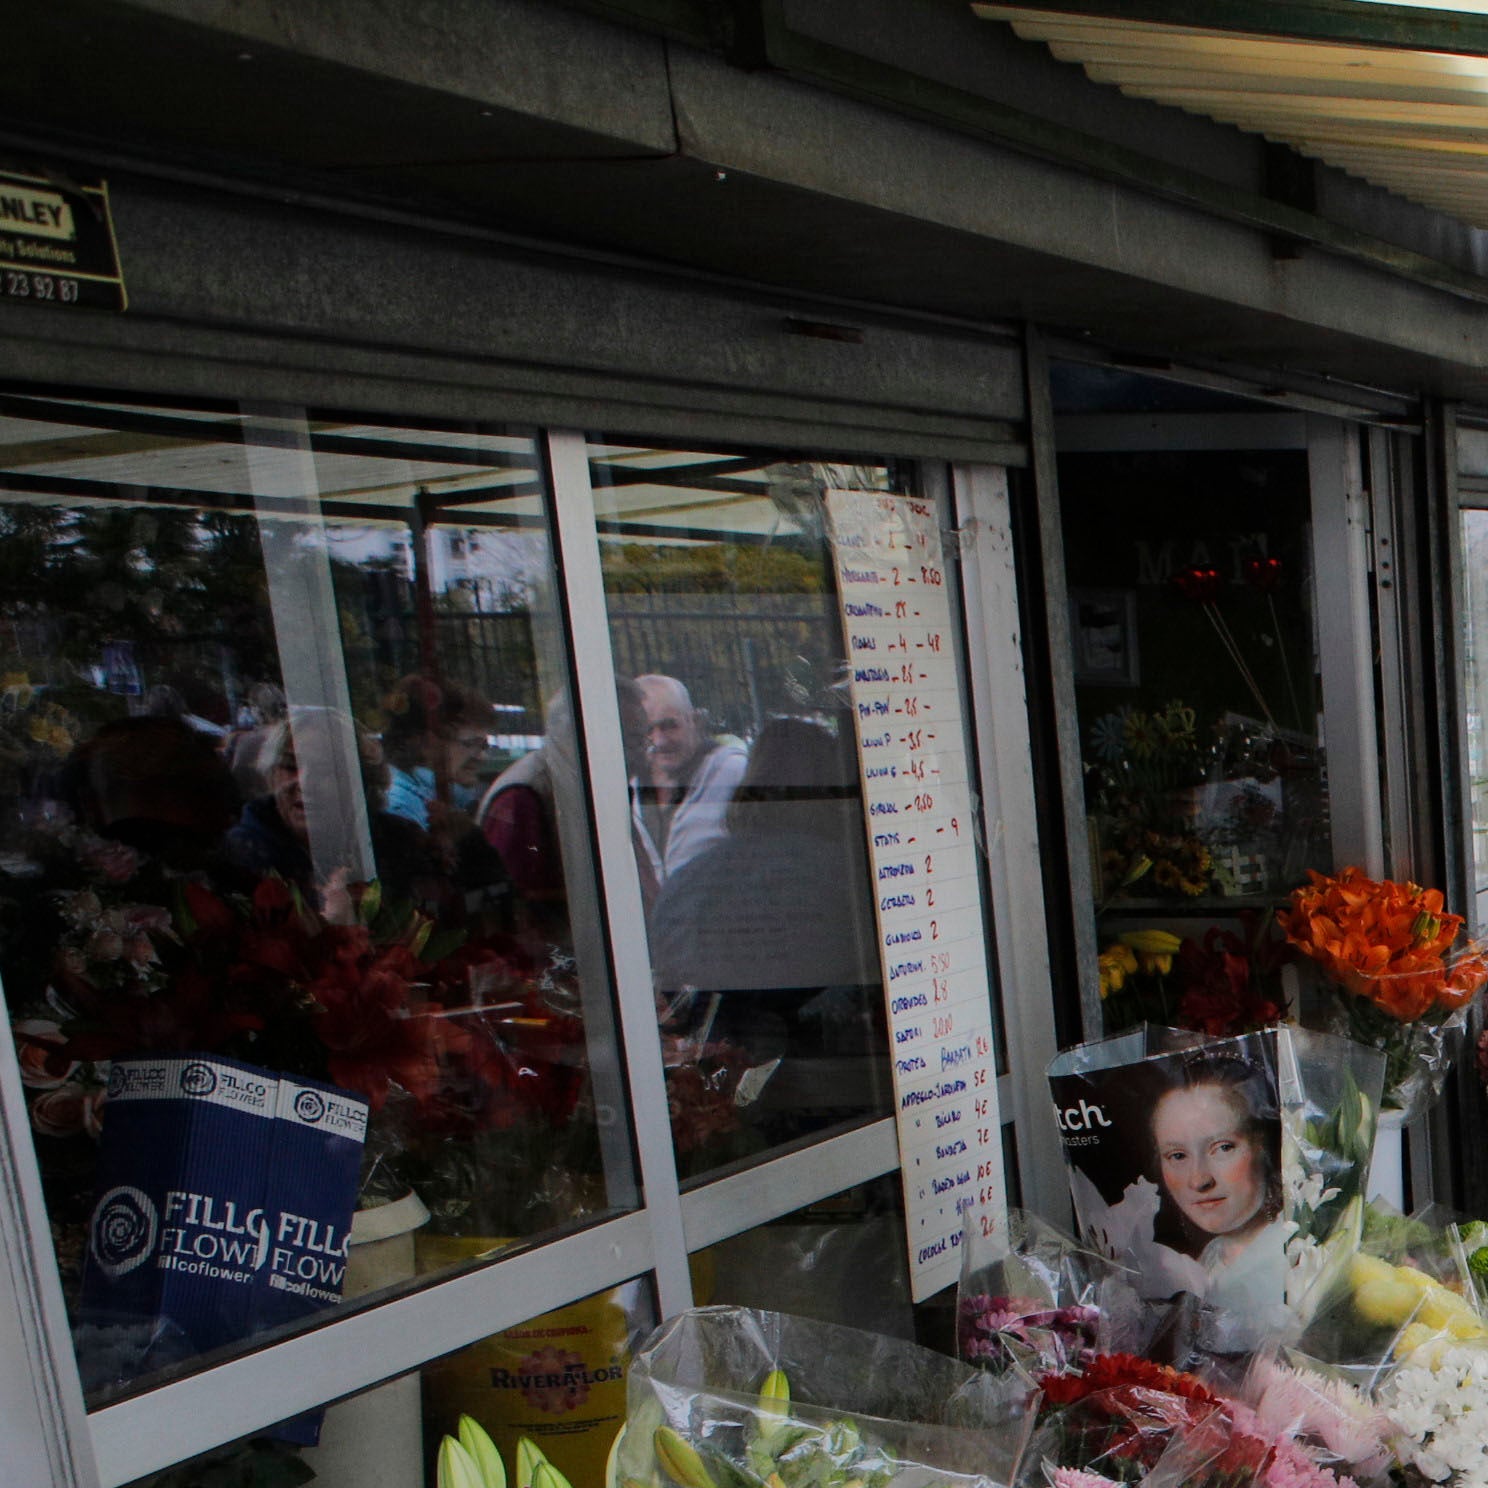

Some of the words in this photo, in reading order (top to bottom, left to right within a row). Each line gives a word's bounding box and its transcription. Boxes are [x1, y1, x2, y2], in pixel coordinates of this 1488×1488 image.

[0, 196, 62, 228] NLEY
[951, 817, 959, 837] 9
[925, 854, 933, 874] 2
[926, 888, 935, 907] 2
[930, 920, 939, 941] 2
[1053, 1099, 1113, 1131] tch
[165, 1190, 264, 1239] FILLC
